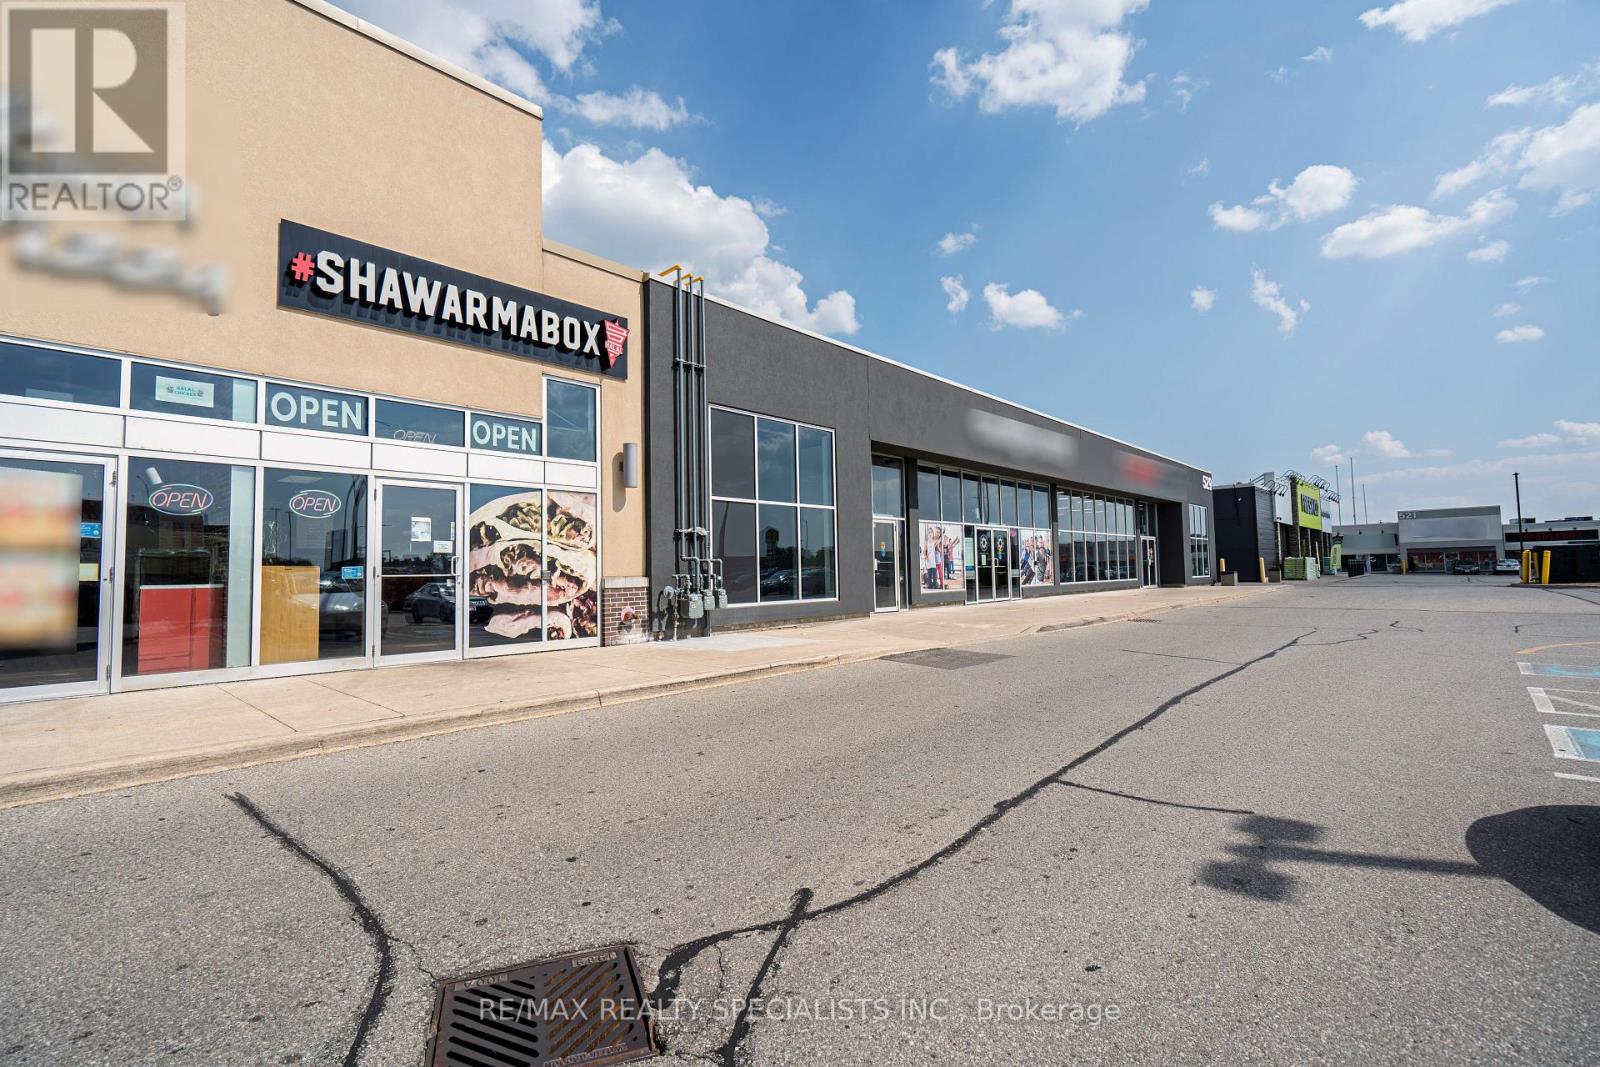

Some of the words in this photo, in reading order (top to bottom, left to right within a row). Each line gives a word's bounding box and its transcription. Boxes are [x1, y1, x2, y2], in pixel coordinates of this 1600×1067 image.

[270, 391, 362, 430] OPEN
[393, 429, 437, 443] OPEN
[472, 420, 537, 452] OPEN
[1202, 475, 1213, 491] 529
[152, 491, 207, 509] OPEN
[291, 497, 337, 512] OPEN
[1398, 511, 1417, 520] 521
